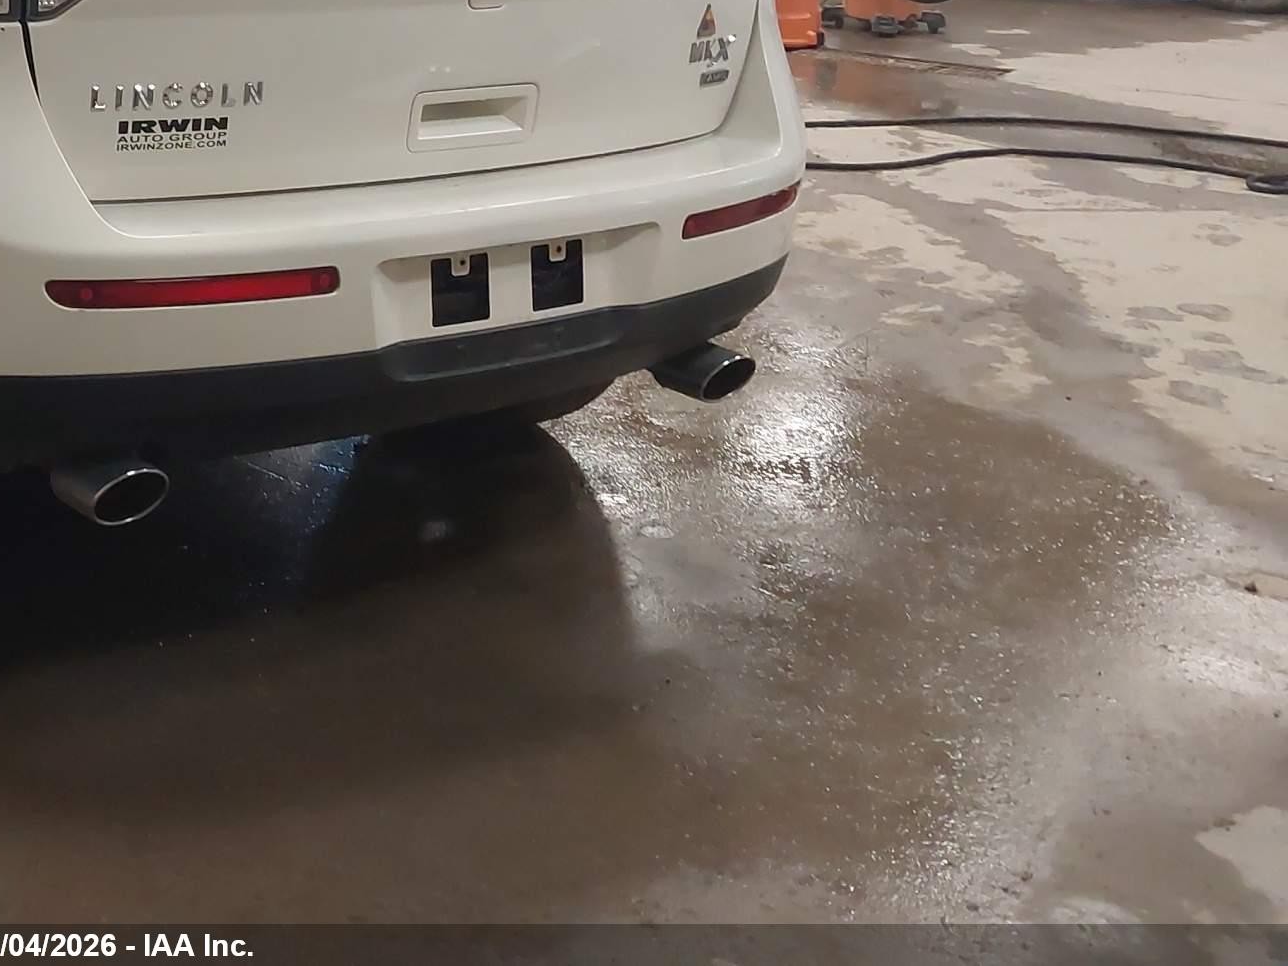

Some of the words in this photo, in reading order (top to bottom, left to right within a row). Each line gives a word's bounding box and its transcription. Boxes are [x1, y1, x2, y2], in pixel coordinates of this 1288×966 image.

[90, 80, 265, 111] LINCOLN
[117, 116, 229, 134] IRWIN
[116, 134, 164, 144] AUTO
[168, 131, 227, 142] GROUP
[115, 140, 227, 152] IRWINZONE.COM
